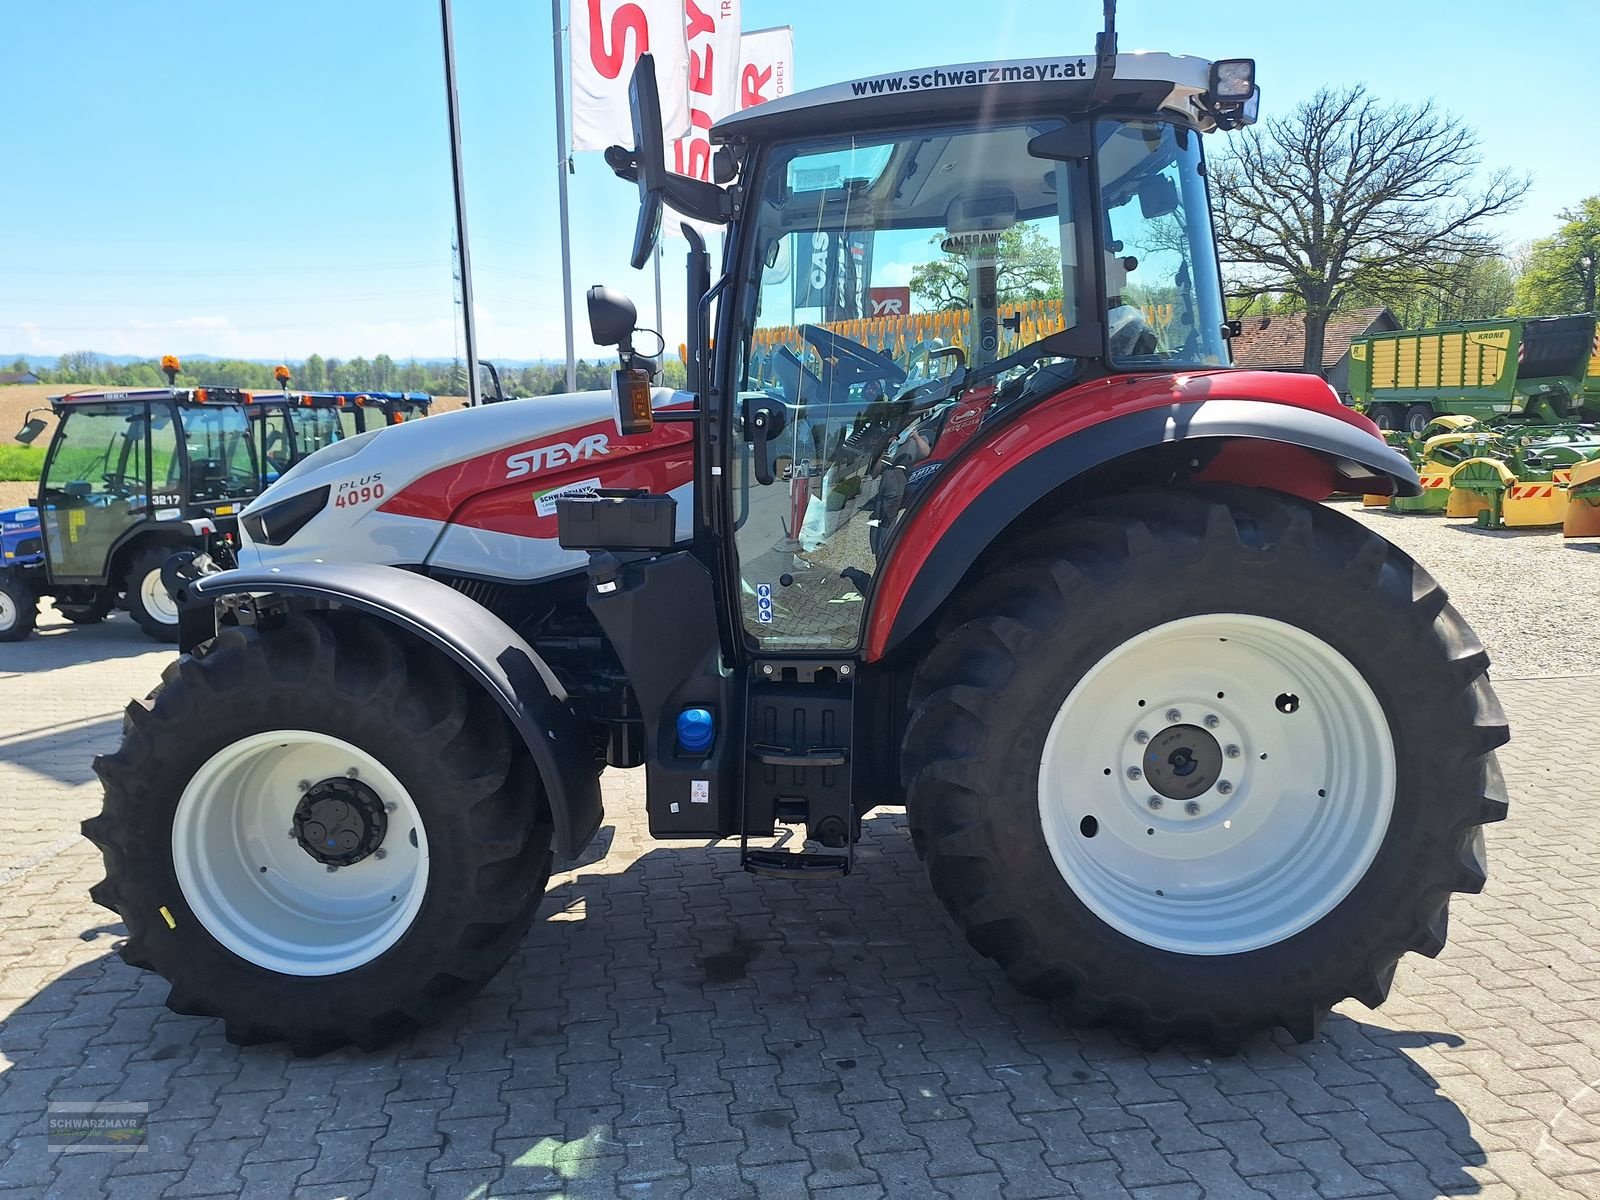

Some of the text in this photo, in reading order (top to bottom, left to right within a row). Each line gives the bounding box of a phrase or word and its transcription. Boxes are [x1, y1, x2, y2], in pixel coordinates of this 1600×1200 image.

[776, 61, 784, 98] OREN
[851, 59, 1087, 96] www.schwarzmayr.at
[1478, 332, 1504, 340] KRONE
[505, 433, 610, 479] STEYR
[339, 472, 383, 492] PLUS
[151, 494, 180, 505] 3217
[335, 483, 385, 508] 4090
